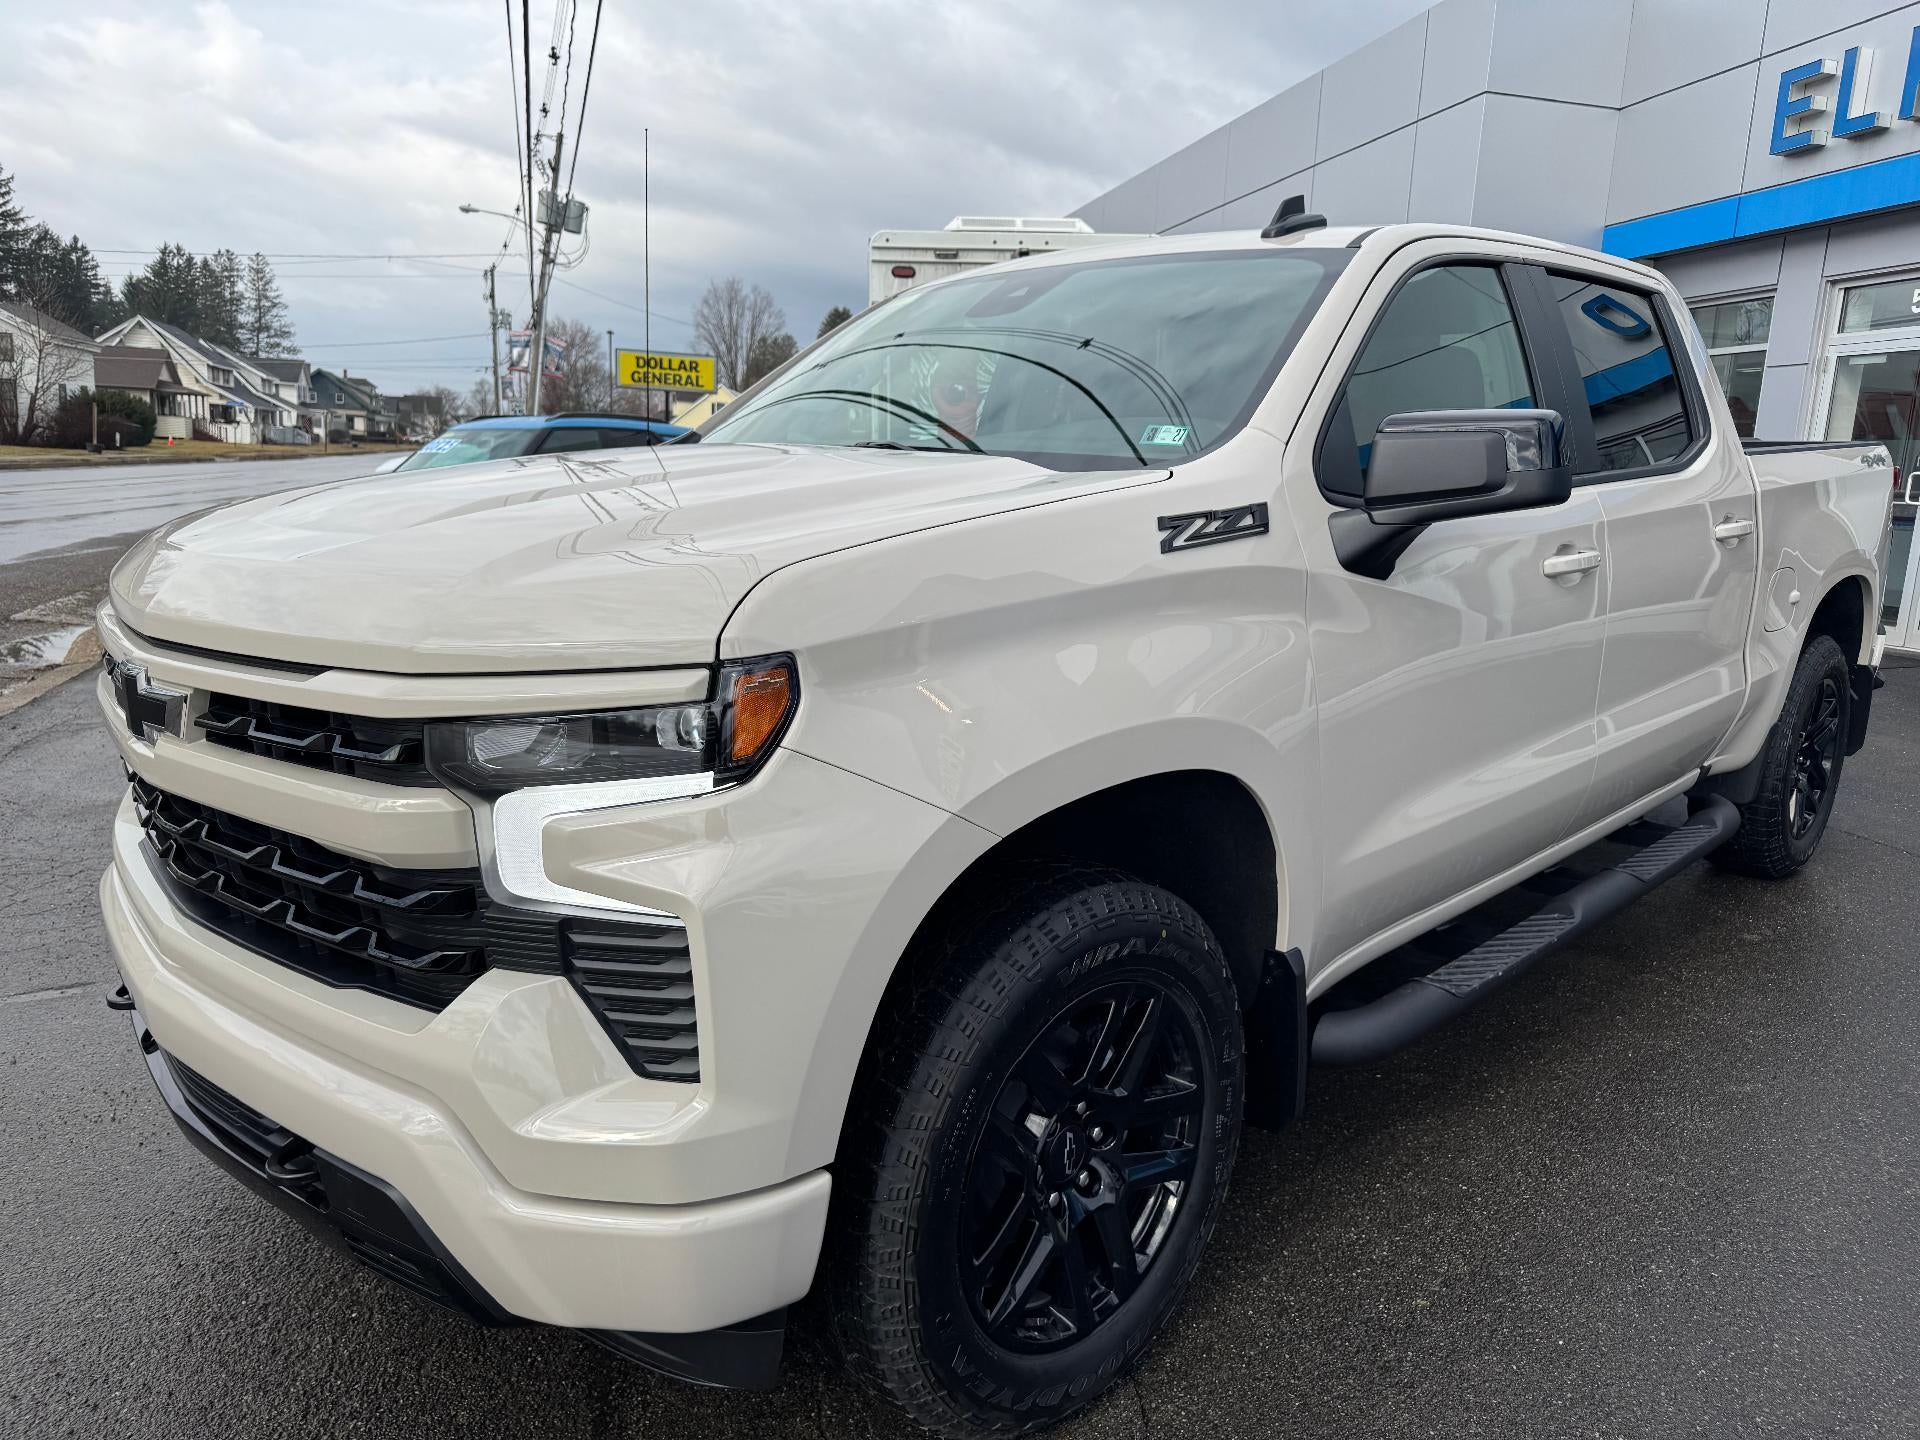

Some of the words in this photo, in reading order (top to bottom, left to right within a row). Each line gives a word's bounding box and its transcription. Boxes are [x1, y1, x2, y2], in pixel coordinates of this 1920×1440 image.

[635, 356, 699, 373] DOLLAR
[631, 370, 704, 388] GENERAL
[1172, 428, 1187, 442] 27
[1157, 501, 1269, 554] Z71
